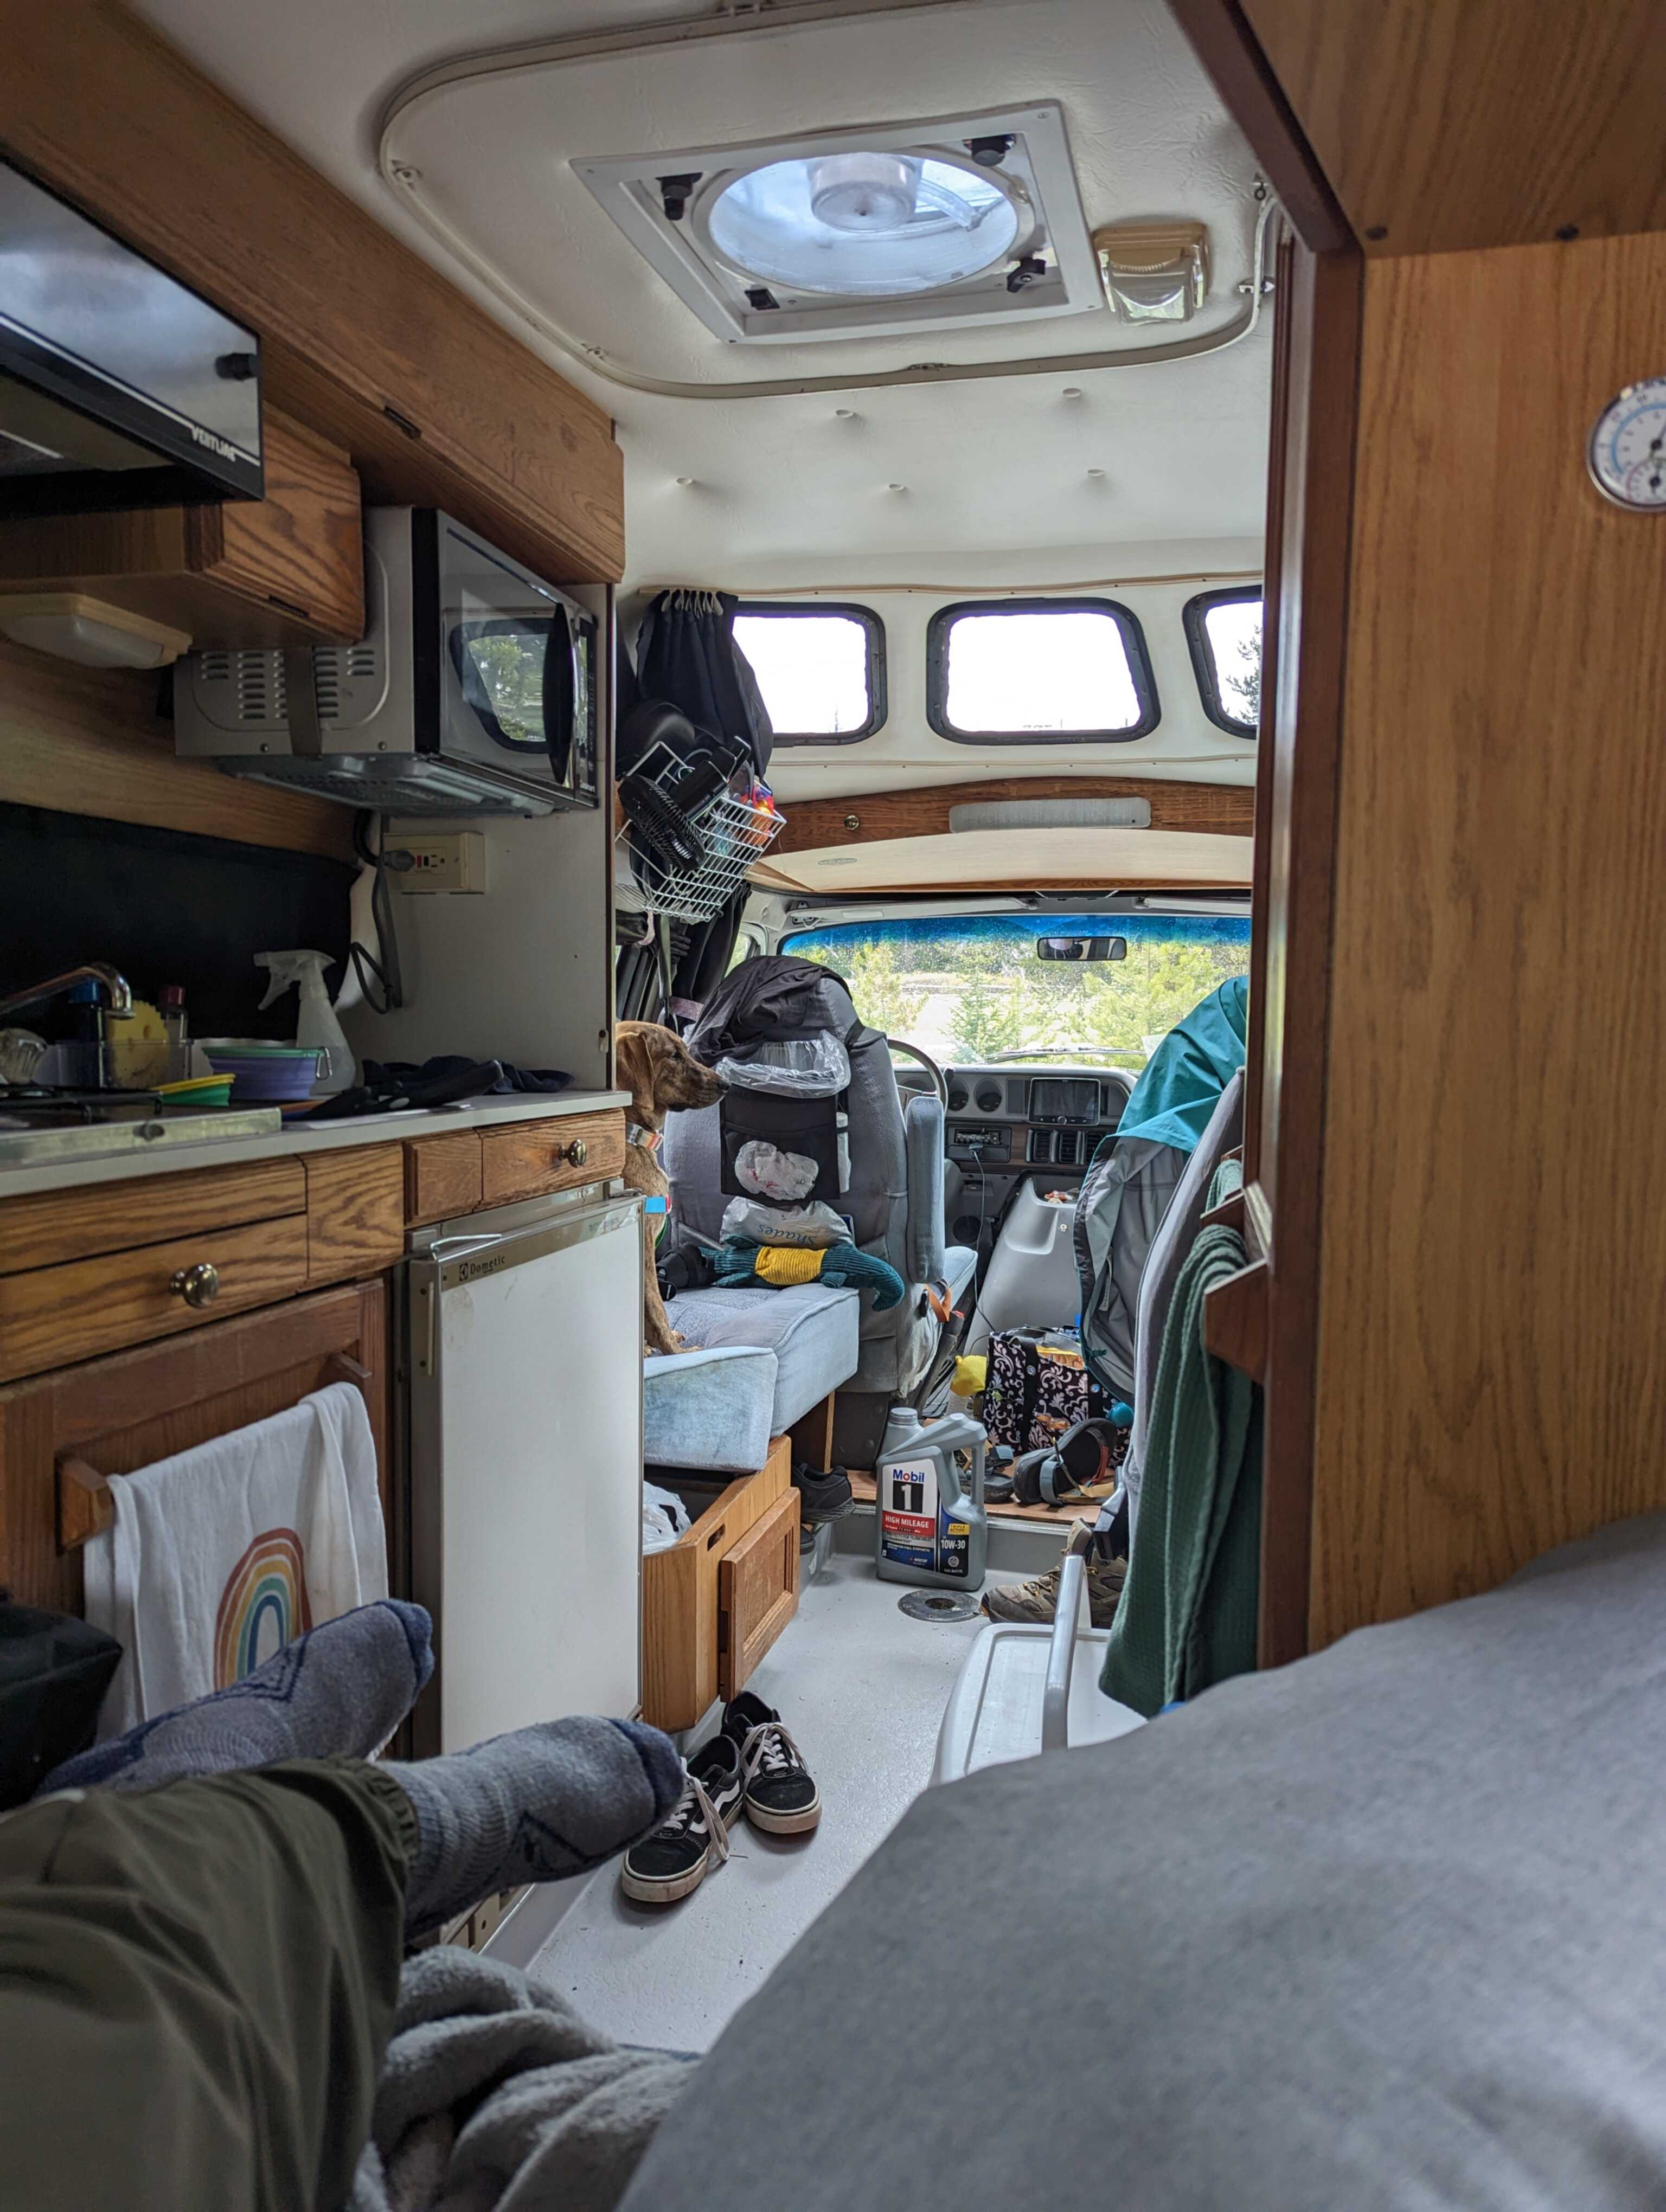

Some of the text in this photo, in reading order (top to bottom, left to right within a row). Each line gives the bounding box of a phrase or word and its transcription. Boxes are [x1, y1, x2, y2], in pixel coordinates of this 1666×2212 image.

[470, 1255, 505, 1275] Dometic
[893, 1469, 925, 1483] Mobil
[901, 1483, 912, 1510] 1
[885, 1515, 929, 1528] HIGH MILEAGE
[941, 1539, 966, 1549] 10W-30
